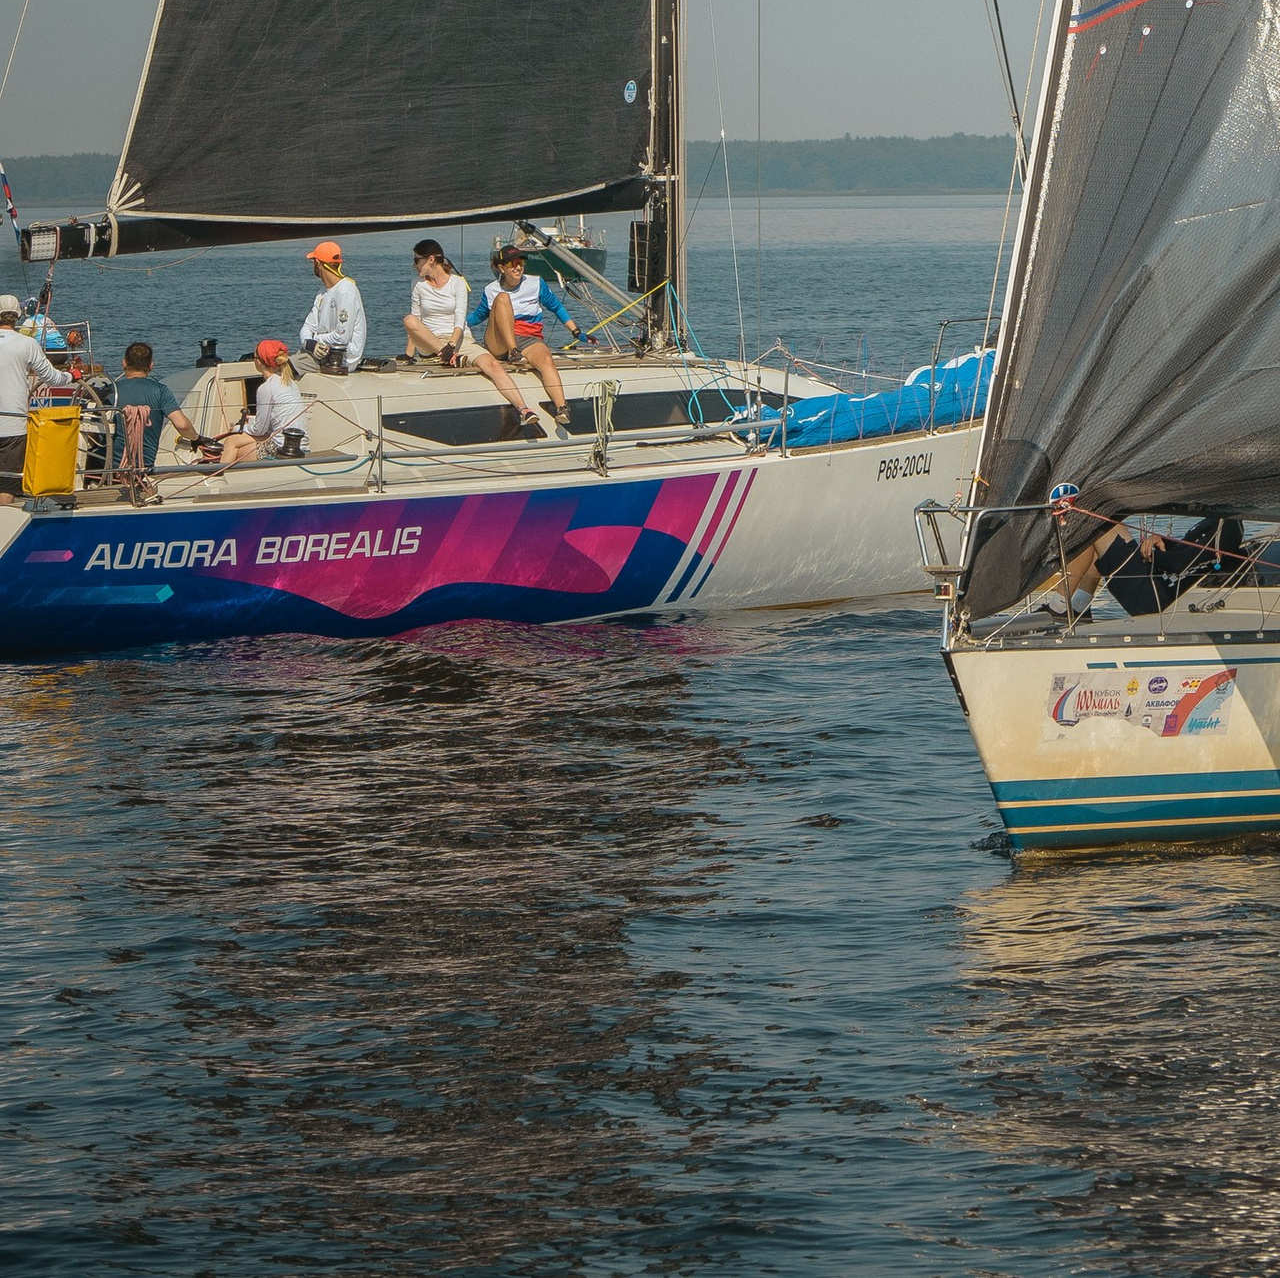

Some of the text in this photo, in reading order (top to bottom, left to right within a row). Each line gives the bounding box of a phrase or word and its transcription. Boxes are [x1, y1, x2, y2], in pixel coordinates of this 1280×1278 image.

[84, 526, 423, 571] AURORA BOREALIS
[1076, 689, 1093, 711] 100
[1093, 689, 1122, 698] КУБОК
